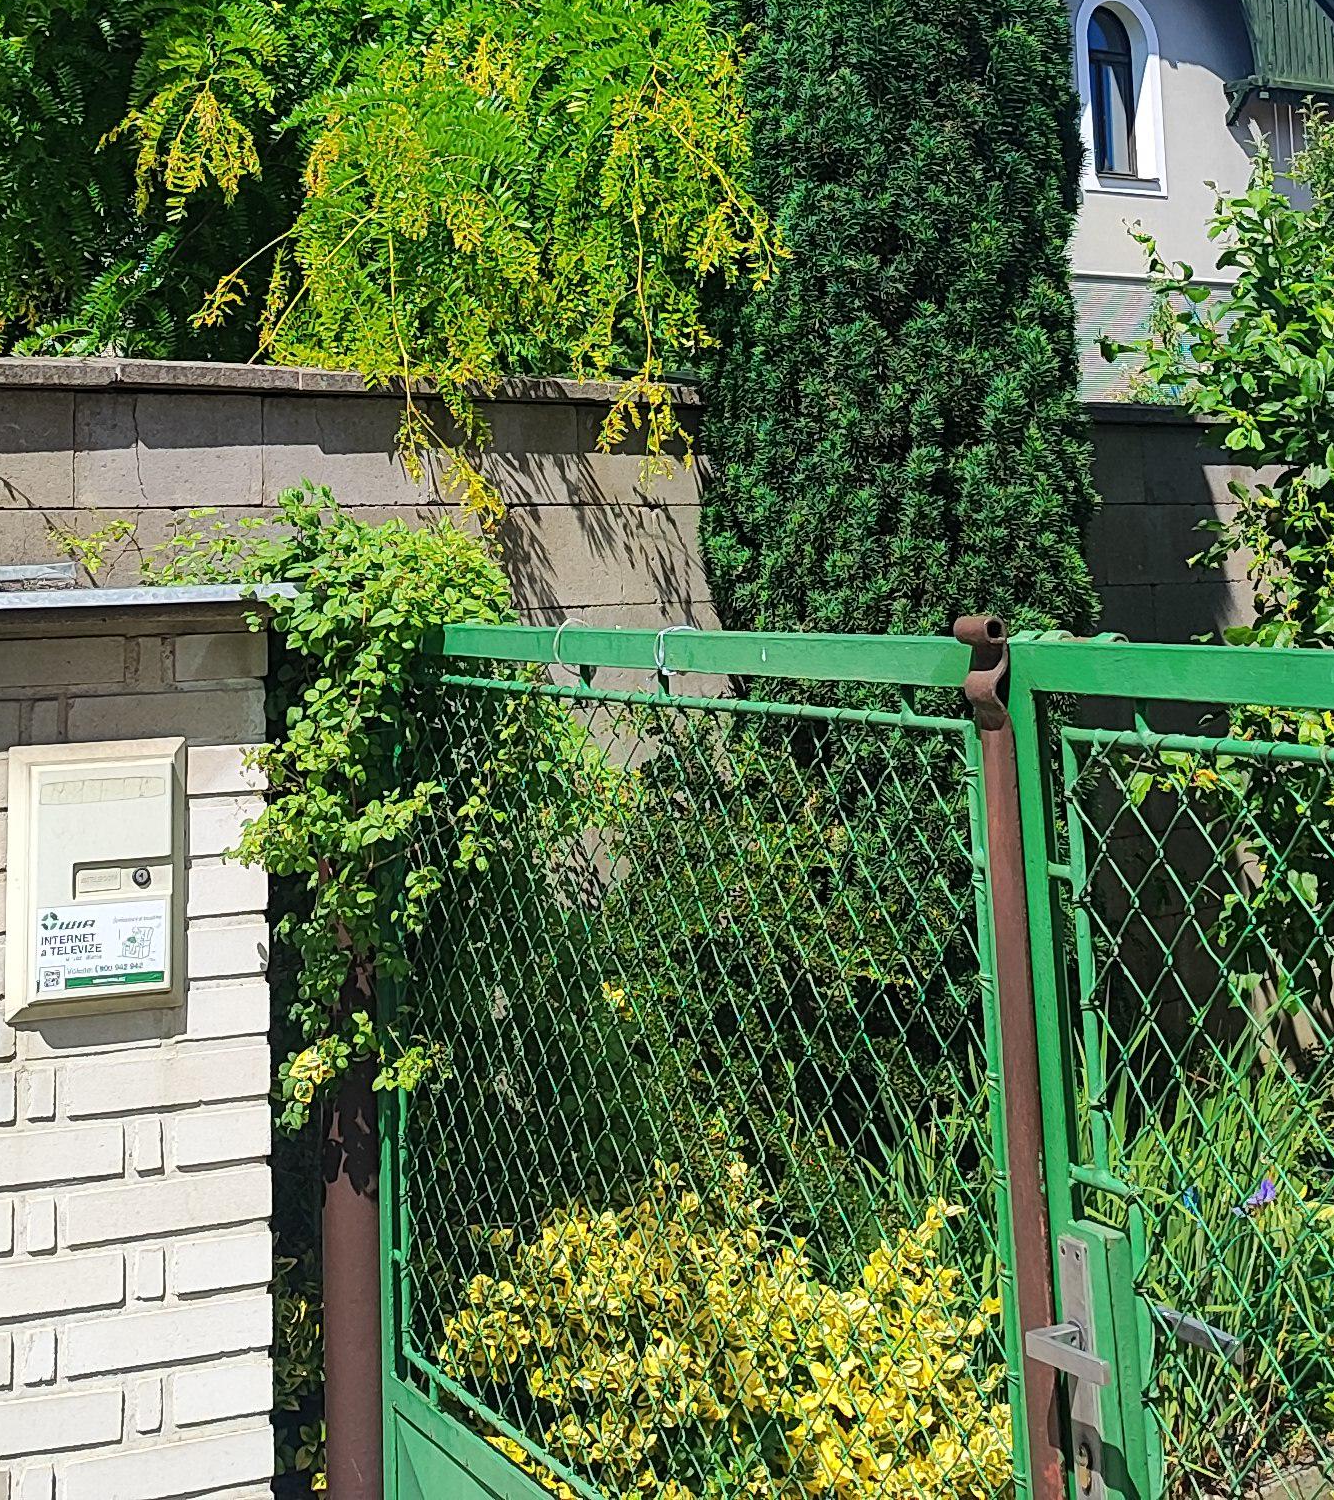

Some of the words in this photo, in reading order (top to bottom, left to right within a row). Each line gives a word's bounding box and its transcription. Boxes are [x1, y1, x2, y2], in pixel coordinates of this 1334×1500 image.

[40, 932, 97, 947] INTERNET
[40, 949, 47, 957] a
[50, 943, 103, 957] TELEVIZE
